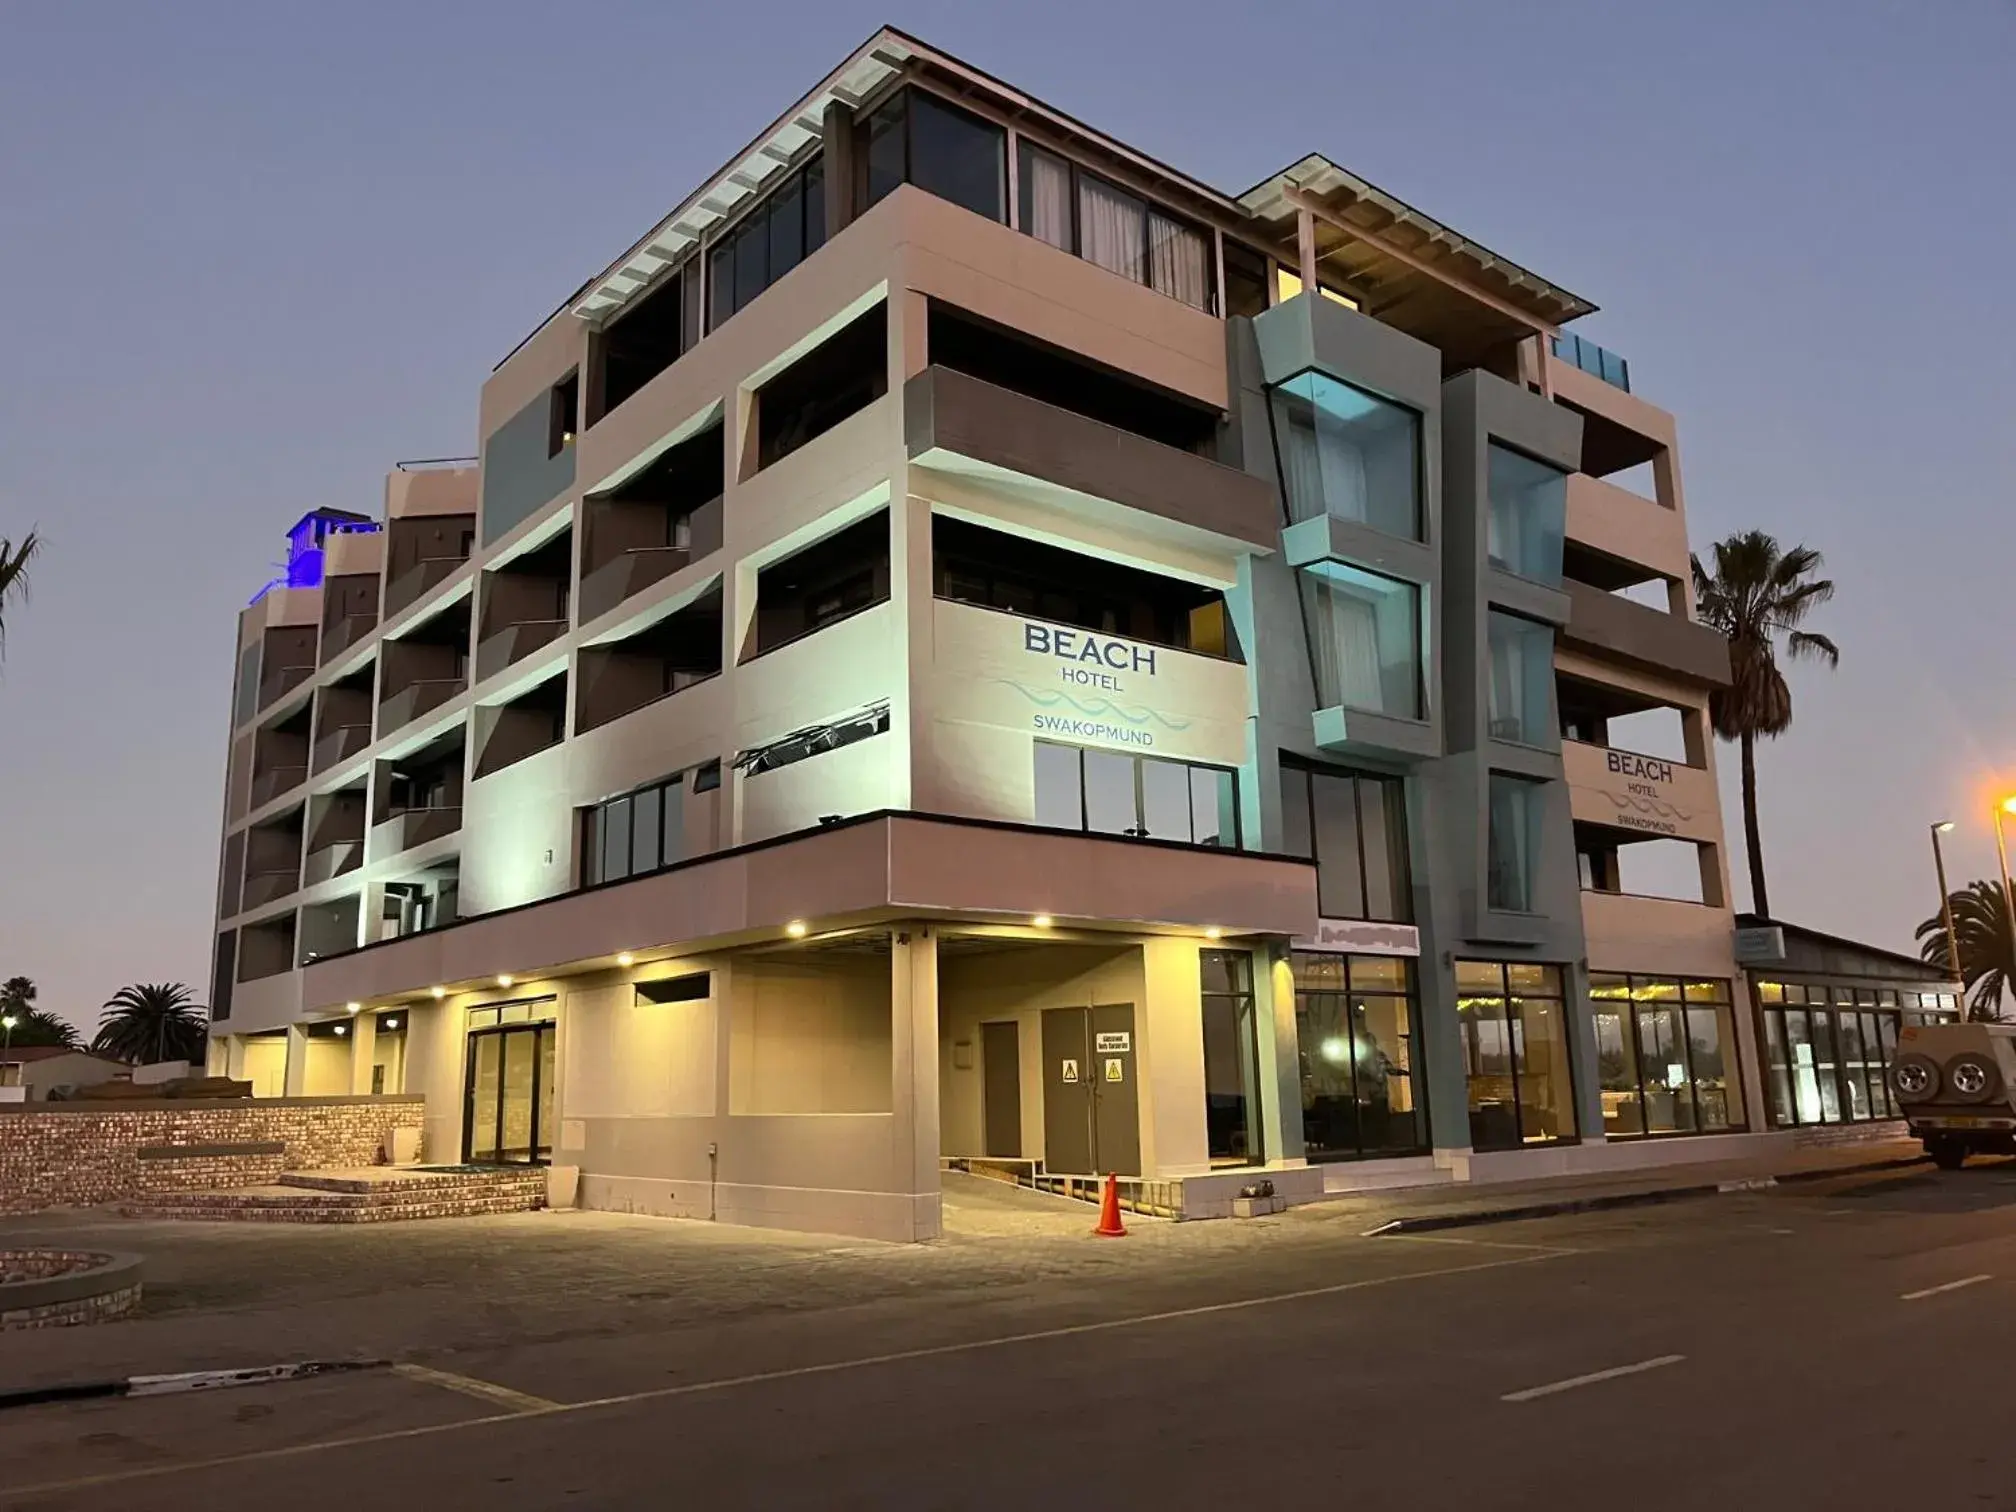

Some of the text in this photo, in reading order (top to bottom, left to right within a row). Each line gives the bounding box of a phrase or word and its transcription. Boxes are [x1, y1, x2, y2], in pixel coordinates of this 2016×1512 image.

[1025, 623, 1155, 675] BEACH
[1062, 667, 1124, 692] HOTEL
[1034, 714, 1153, 746] SWAKOPMUND
[1608, 752, 1672, 783] BEACH
[1628, 783, 1659, 798] HOTEL
